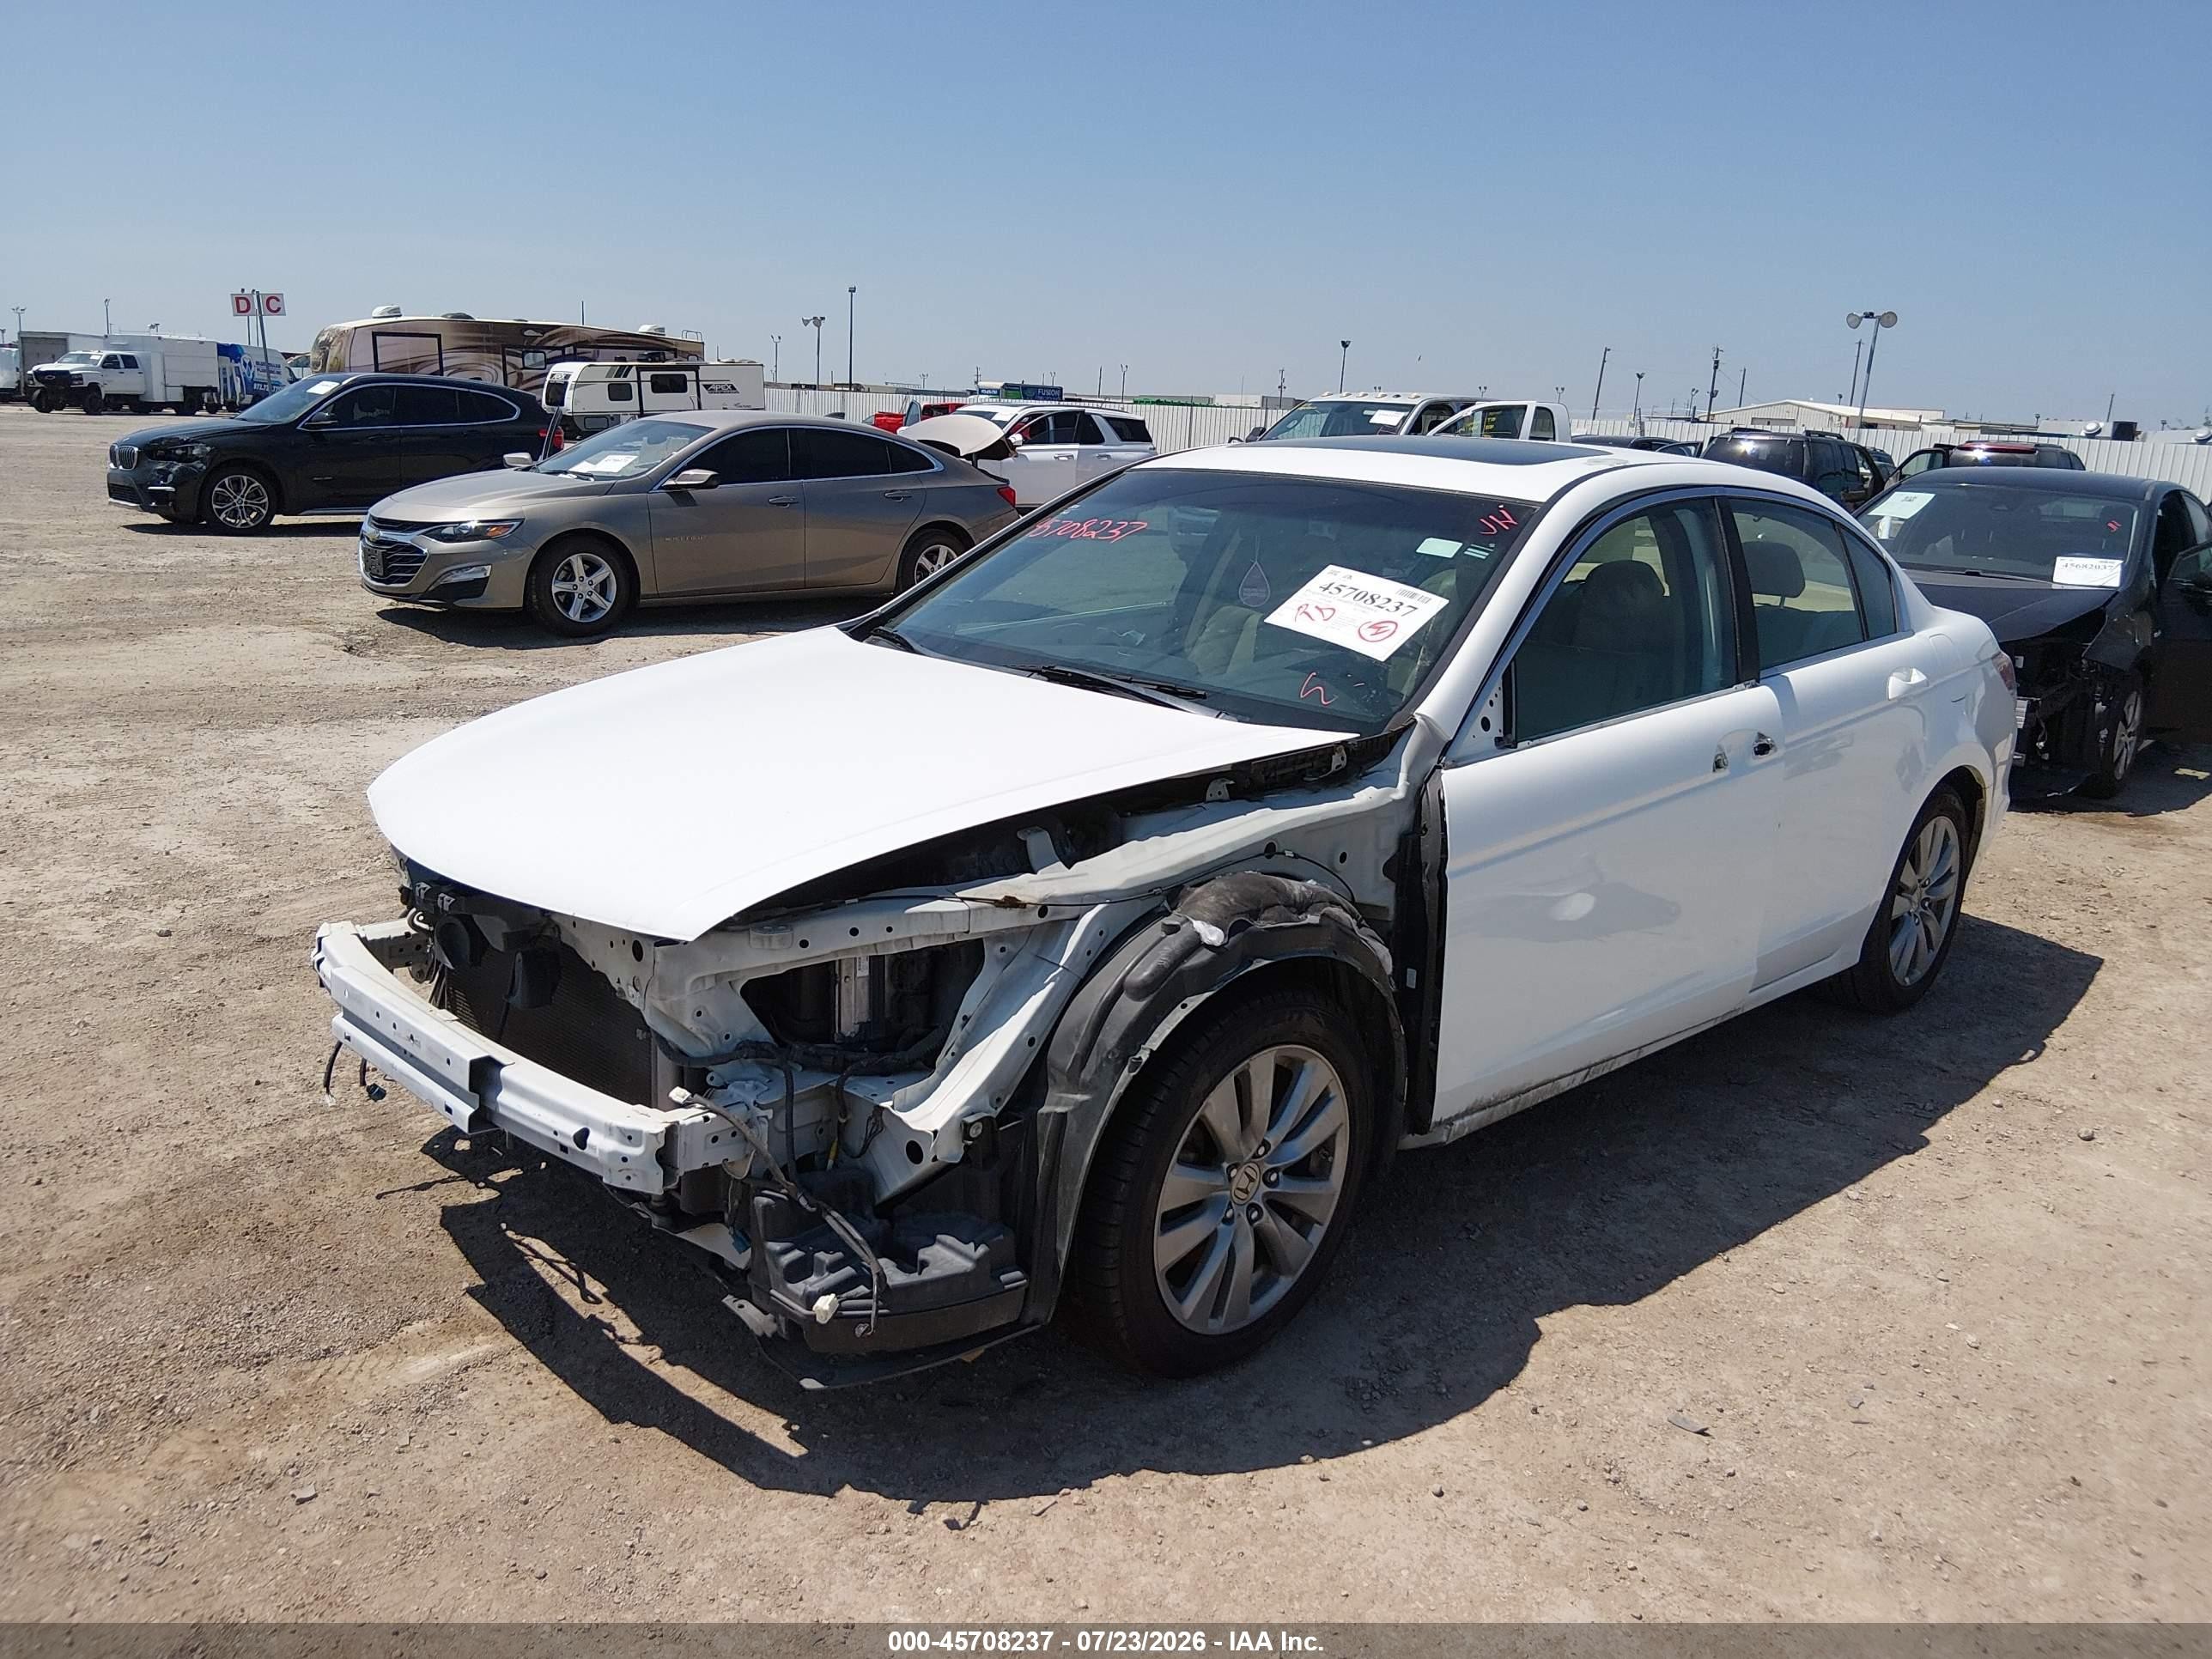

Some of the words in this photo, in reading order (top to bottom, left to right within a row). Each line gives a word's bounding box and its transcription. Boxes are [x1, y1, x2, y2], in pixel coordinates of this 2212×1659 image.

[235, 296, 251, 313] D
[266, 296, 282, 313] C
[1318, 581, 1419, 617] 45708237
